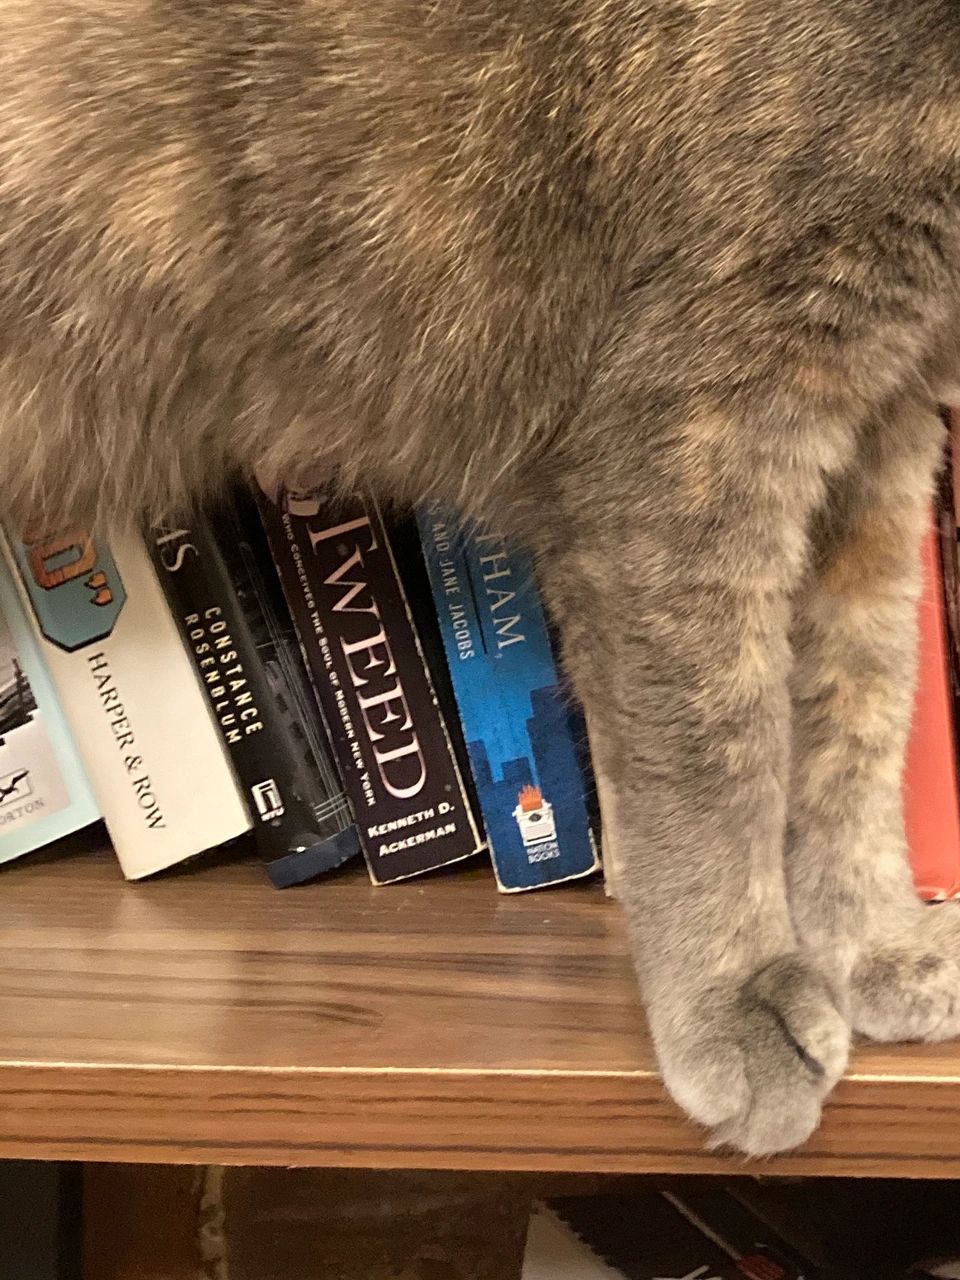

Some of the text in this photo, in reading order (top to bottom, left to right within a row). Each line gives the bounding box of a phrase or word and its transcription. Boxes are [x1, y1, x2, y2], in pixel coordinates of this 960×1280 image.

[432, 522, 449, 552] AND
[439, 558, 460, 596] JANE
[449, 604, 475, 660] JACOBS
[184, 613, 241, 744] ROSENBLUM
[204, 606, 263, 736] CONSTANCE
[305, 516, 427, 799] TWEED
[87, 652, 166, 830] HARPER & ROW
[368, 801, 455, 839] KENNETH D.
[379, 821, 457, 857] ACKERMAN
[528, 849, 560, 865] BOOKS
